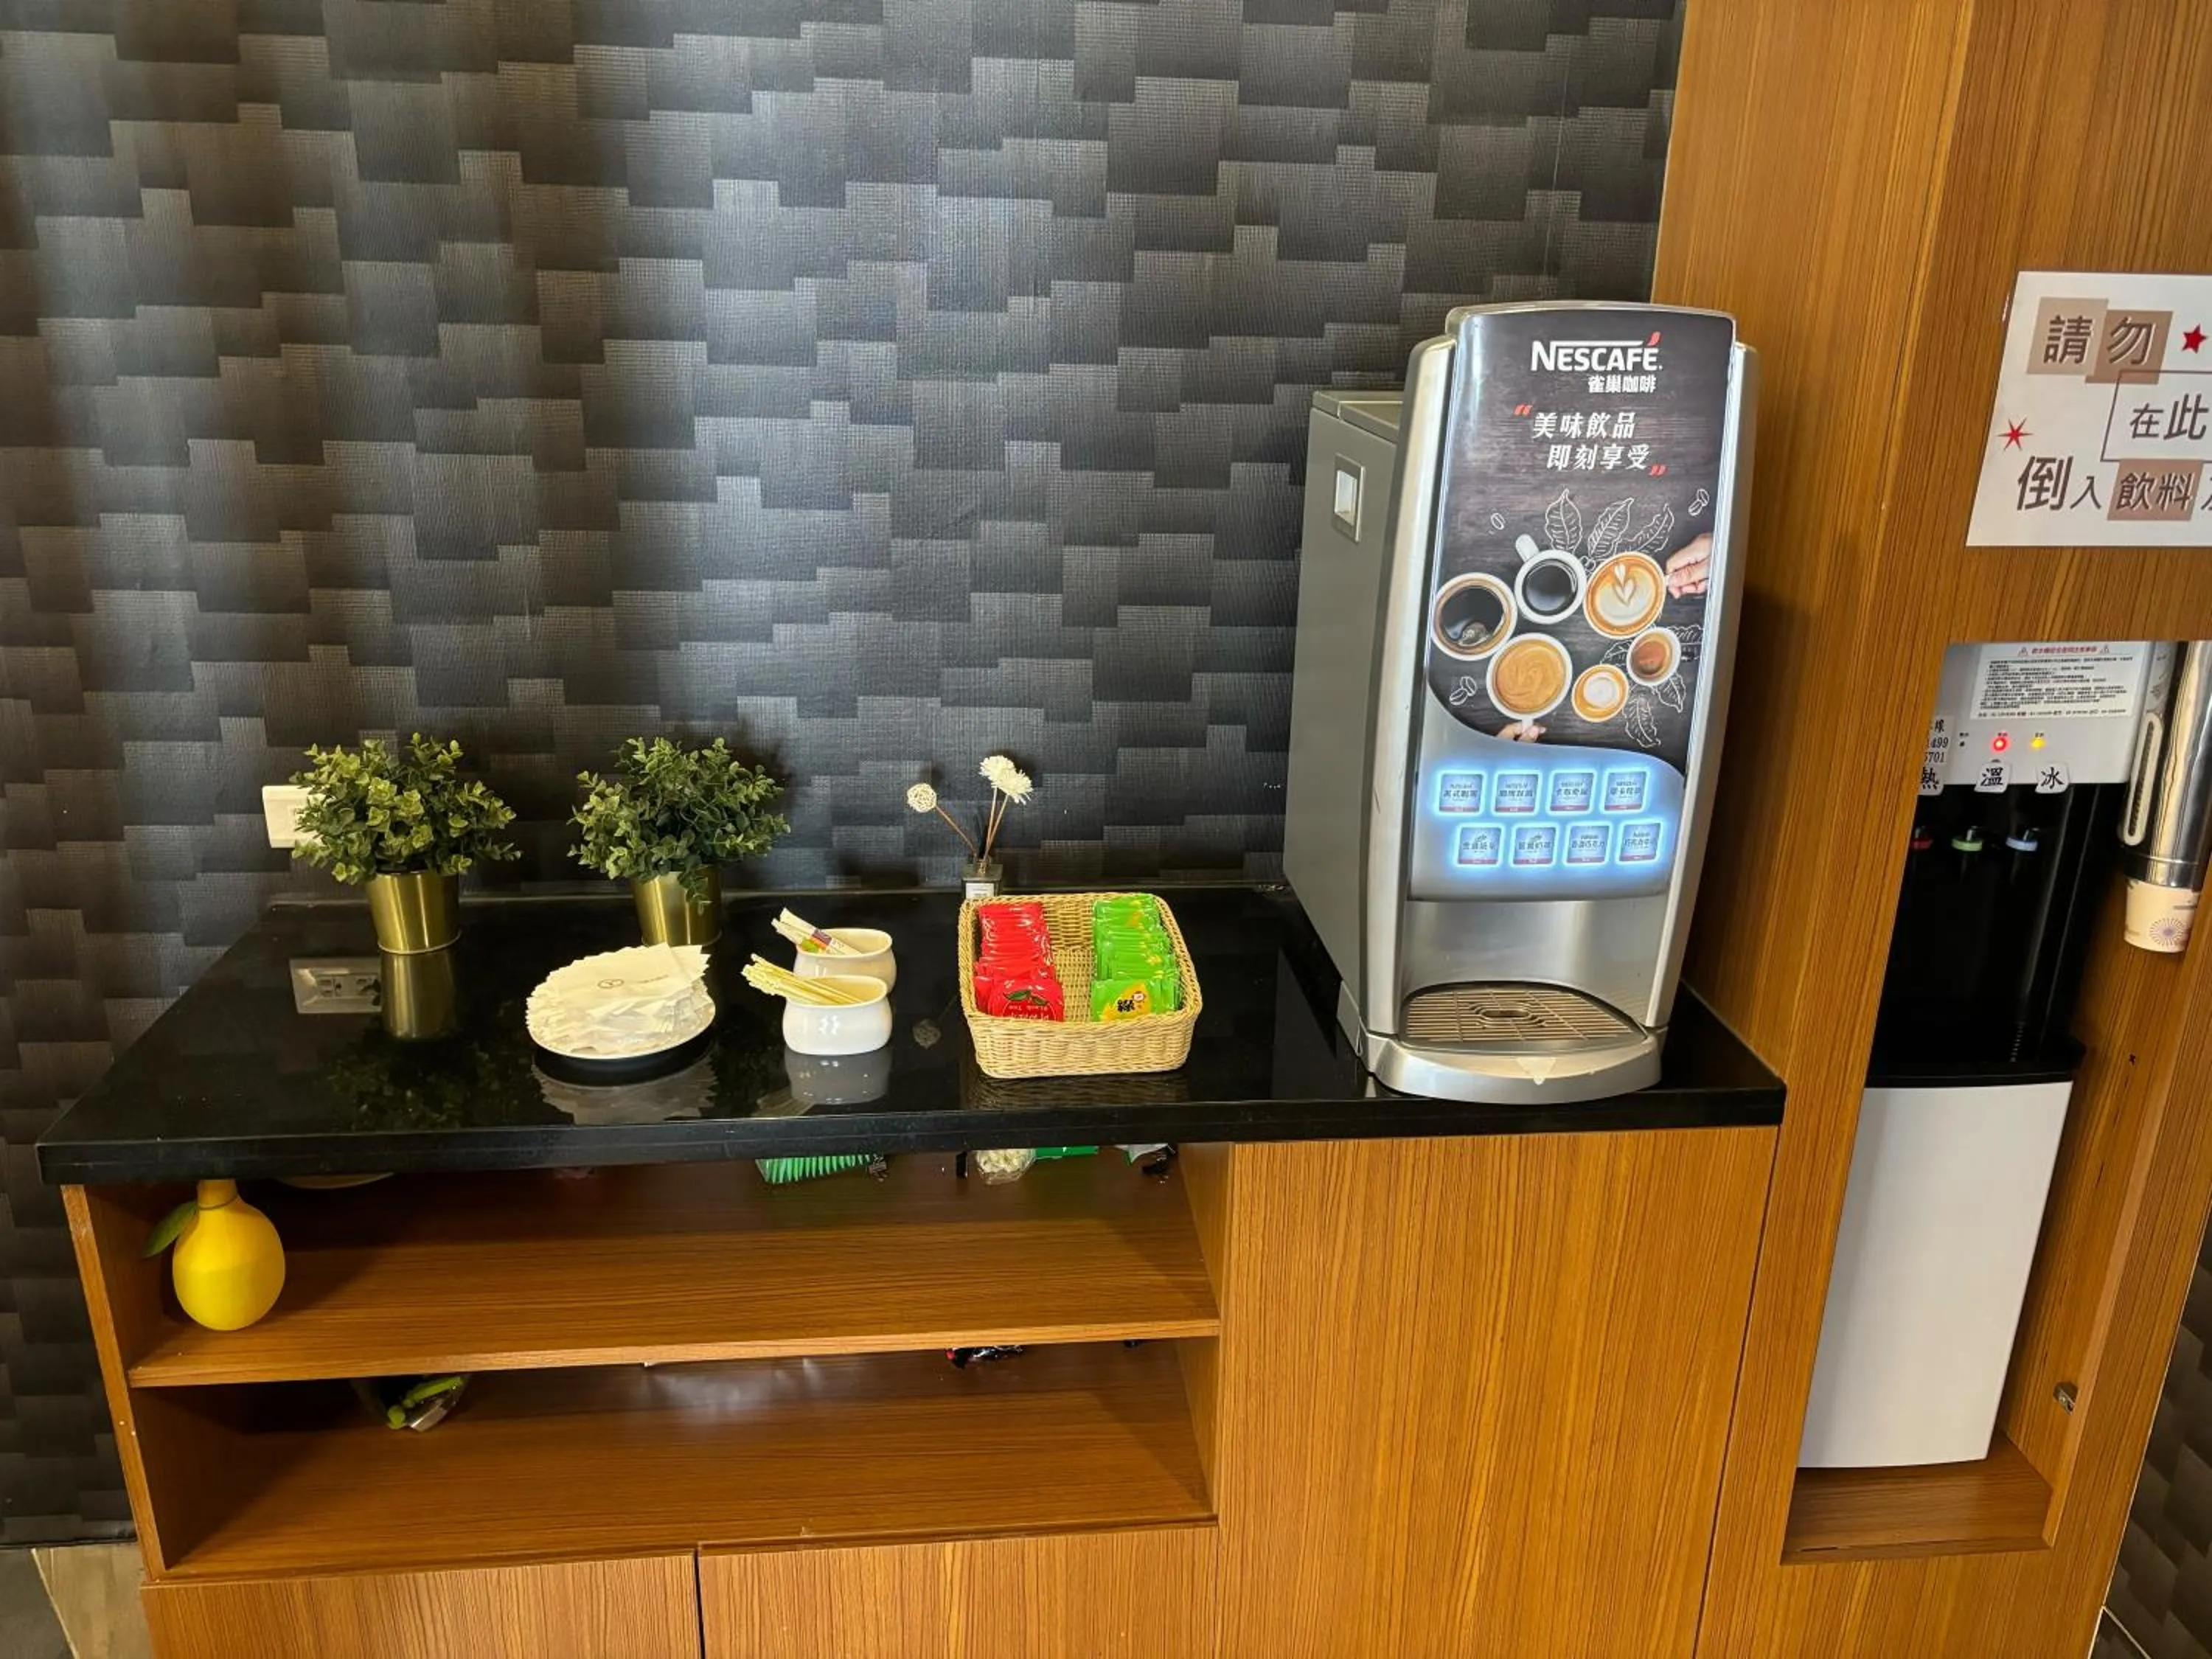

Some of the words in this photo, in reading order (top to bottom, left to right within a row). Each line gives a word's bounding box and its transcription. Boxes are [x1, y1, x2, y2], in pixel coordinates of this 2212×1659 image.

[2043, 315, 2156, 364] 請勿
[1587, 374, 1657, 393] 雀巢咖啡
[2129, 394, 2210, 440] 在此
[2040, 767, 2063, 789] 冰
